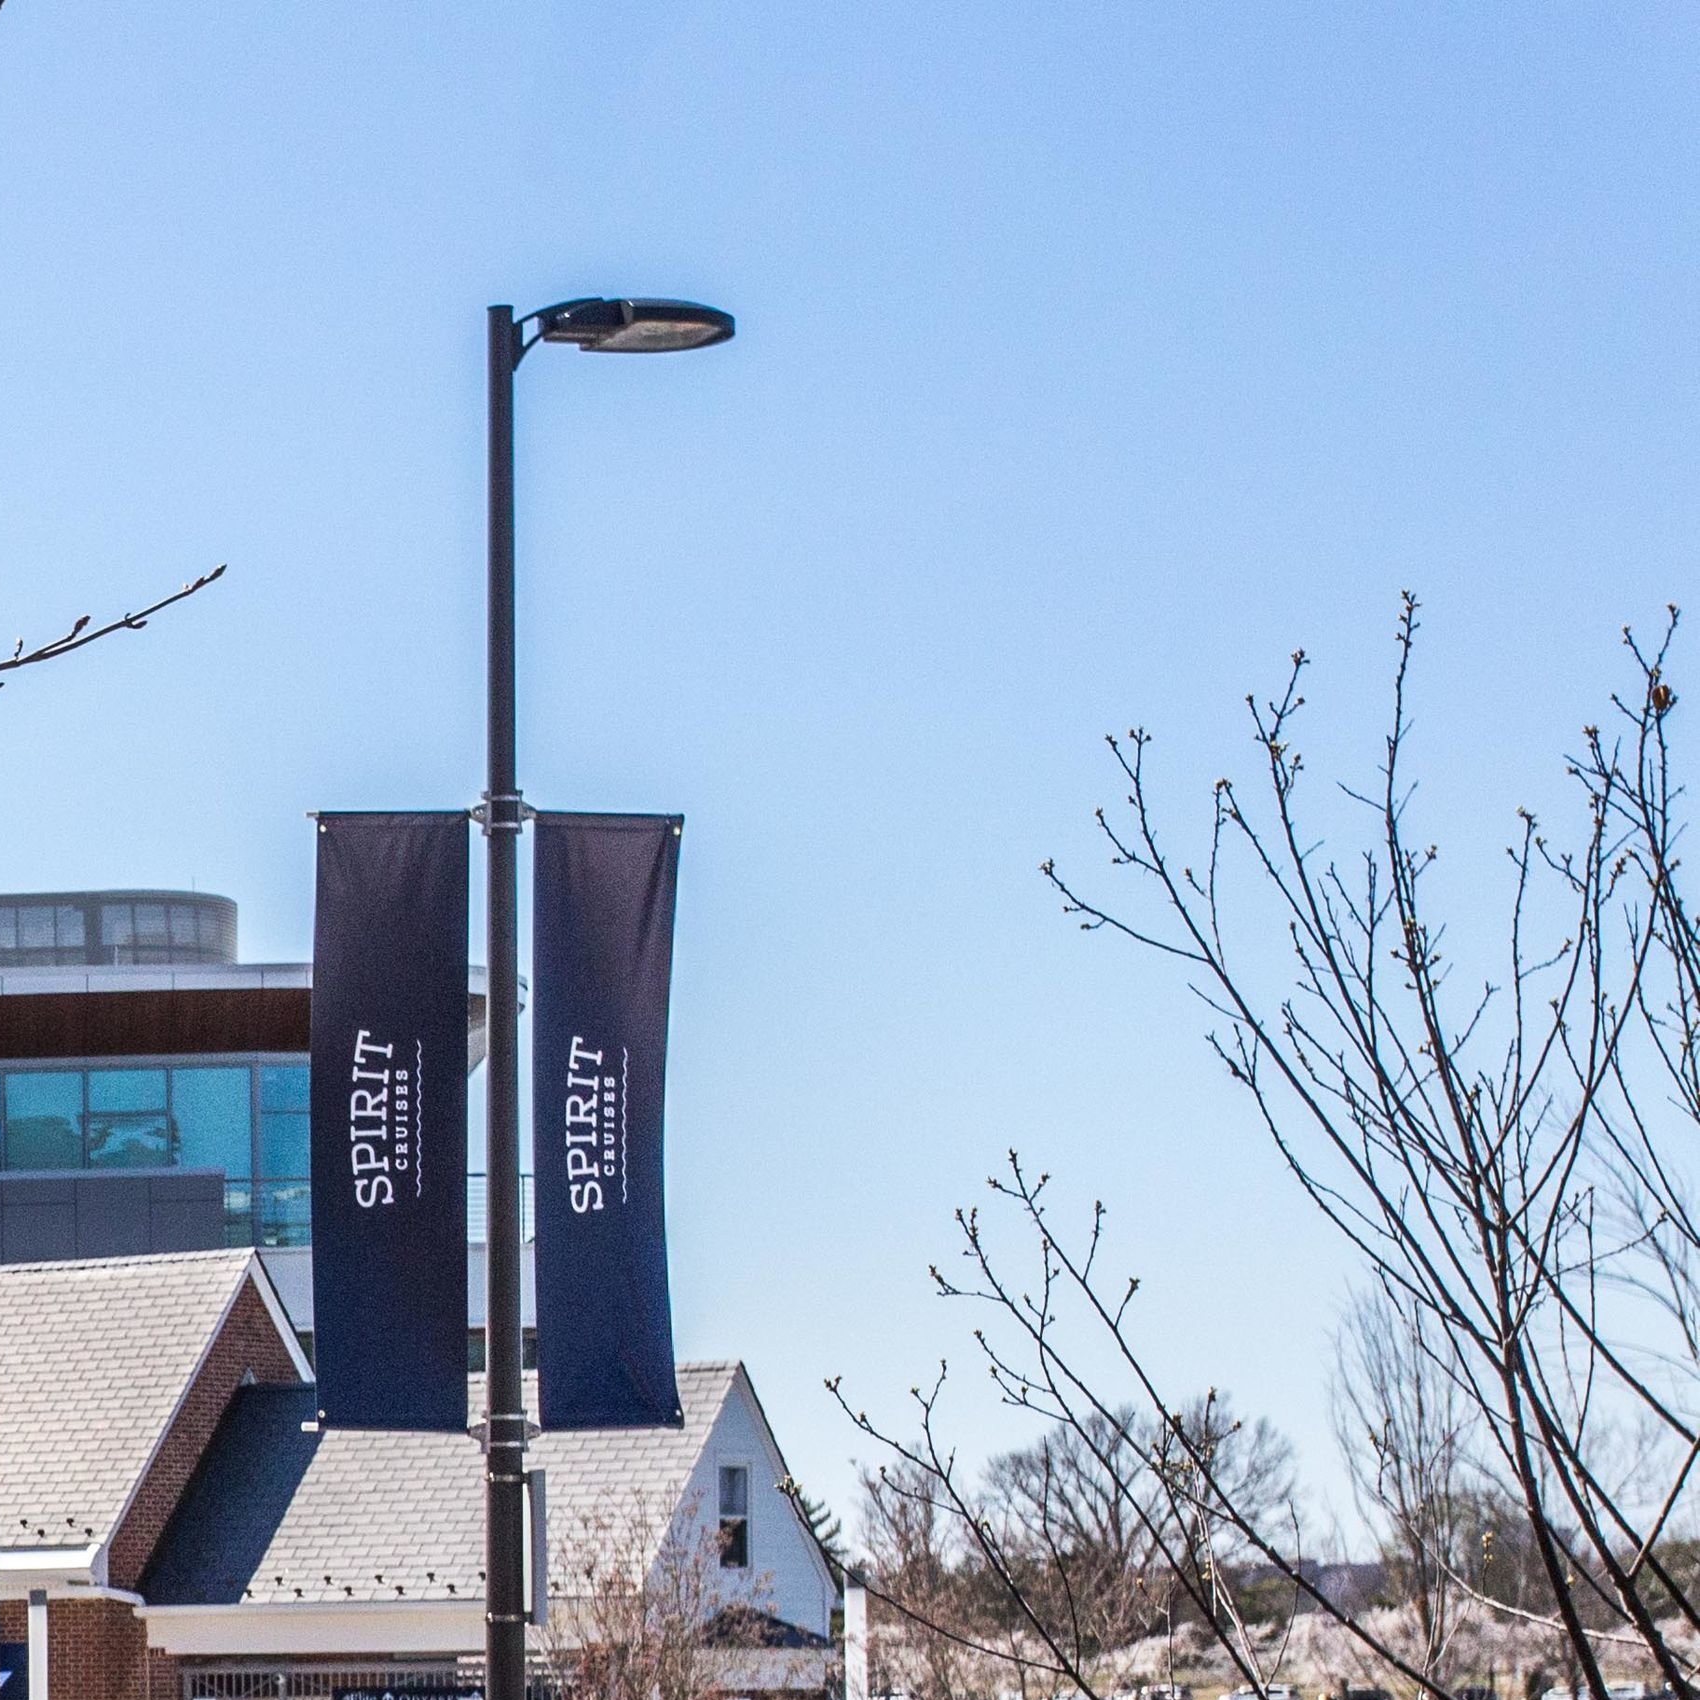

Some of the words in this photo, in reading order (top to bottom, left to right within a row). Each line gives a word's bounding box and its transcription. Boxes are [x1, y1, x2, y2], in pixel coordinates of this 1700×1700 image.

[349, 1029, 394, 1209] SPIRIT
[394, 1068, 408, 1171] CRUISES
[565, 1036, 604, 1214] SPIRIT
[603, 1074, 616, 1177] CRUISES
